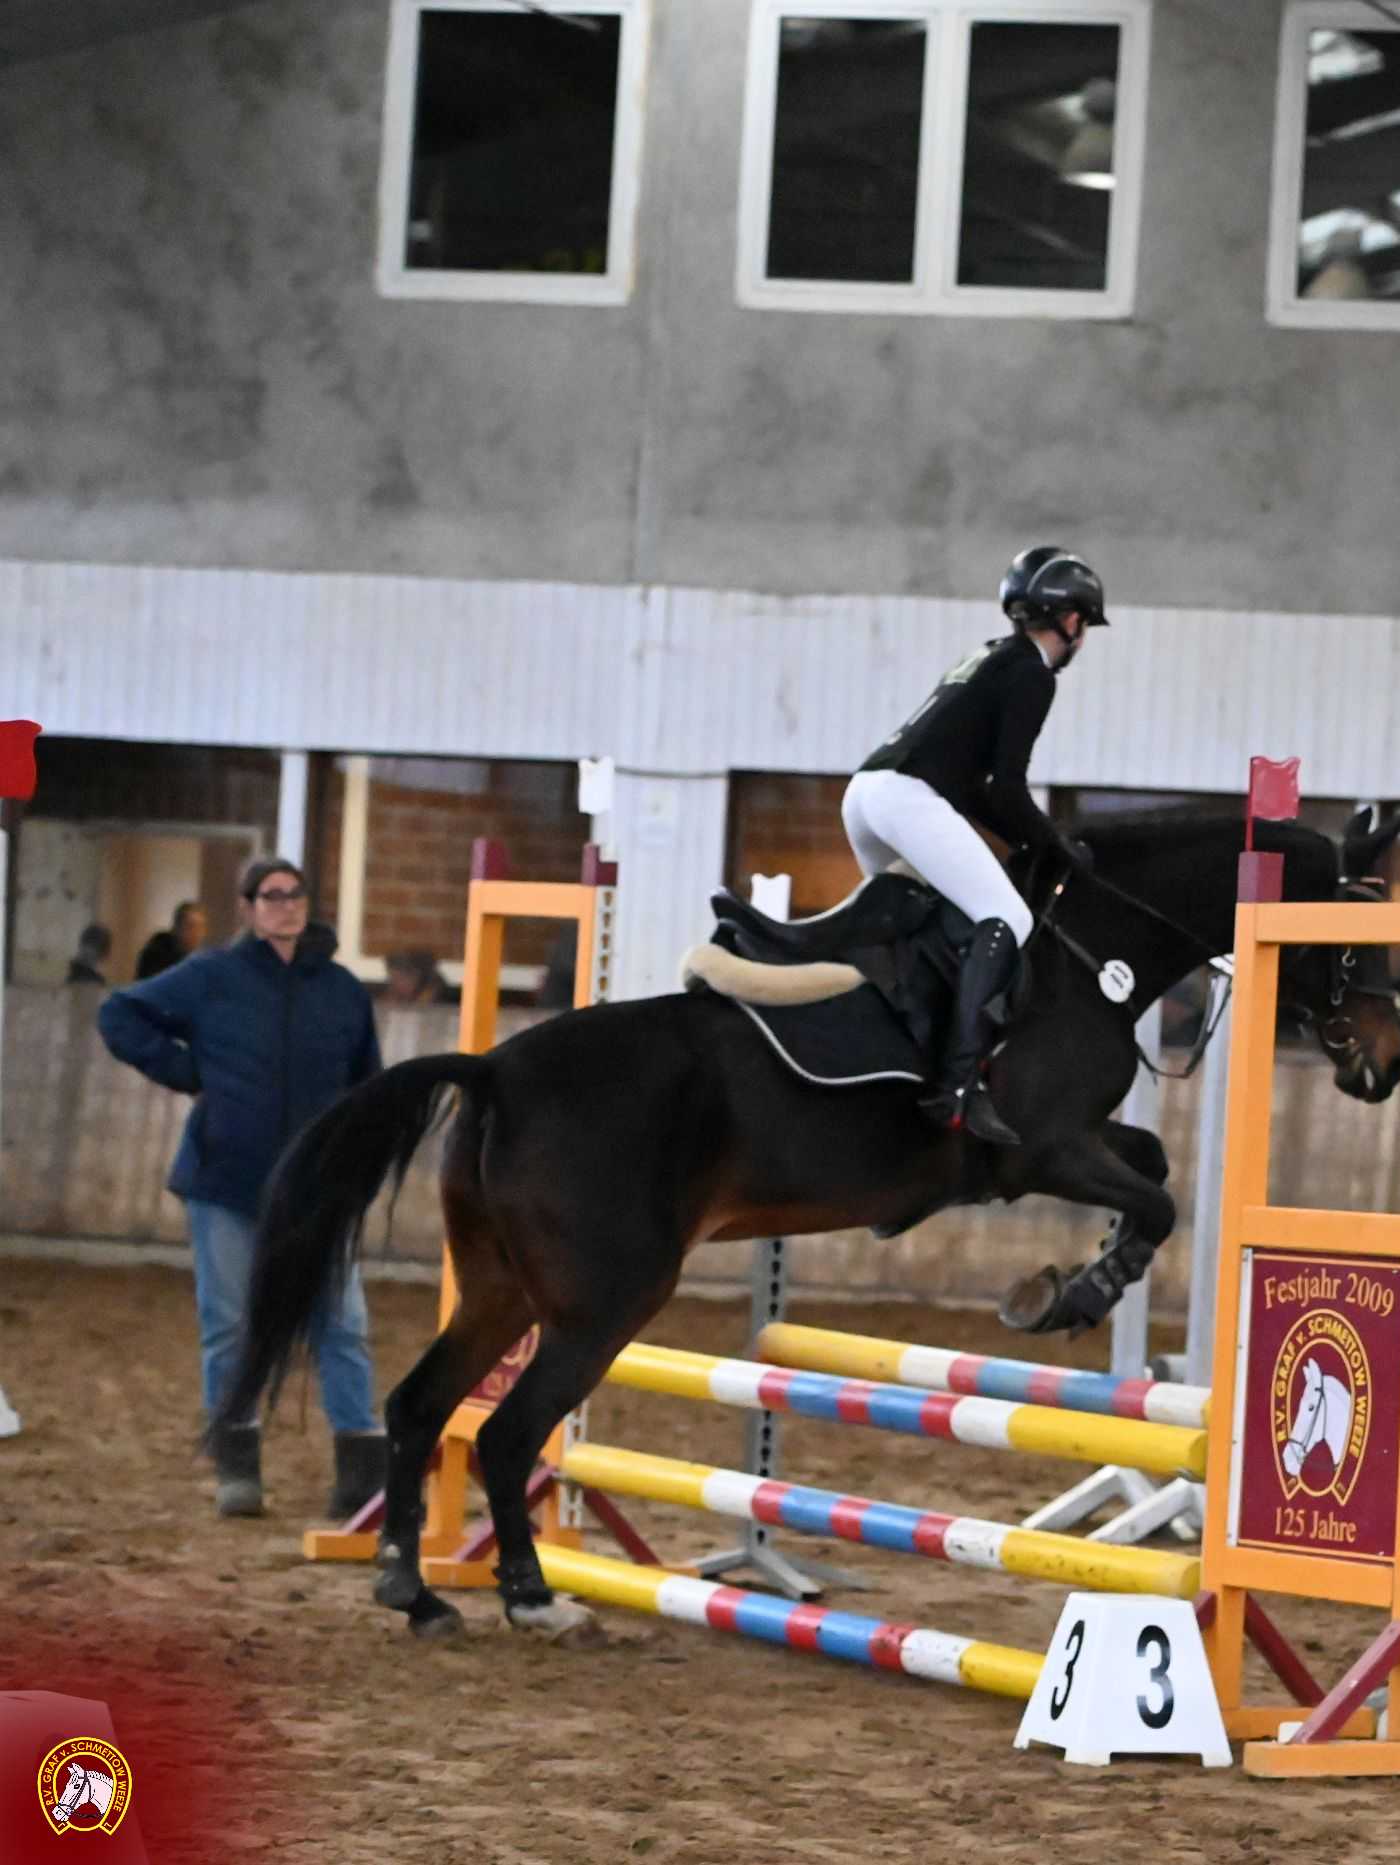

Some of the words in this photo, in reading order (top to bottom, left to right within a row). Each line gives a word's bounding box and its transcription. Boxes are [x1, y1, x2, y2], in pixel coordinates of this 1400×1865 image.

[1263, 1267, 1341, 1309] Festjahr
[1345, 1272, 1394, 1317] 2009
[1275, 1342, 1296, 1397] GRAF
[1307, 1317, 1367, 1387] SCHMETTOW
[1275, 1507, 1305, 1536] 125
[1309, 1510, 1357, 1543] Jahre
[1050, 1619, 1085, 1721] 3
[1136, 1625, 1174, 1729] 3
